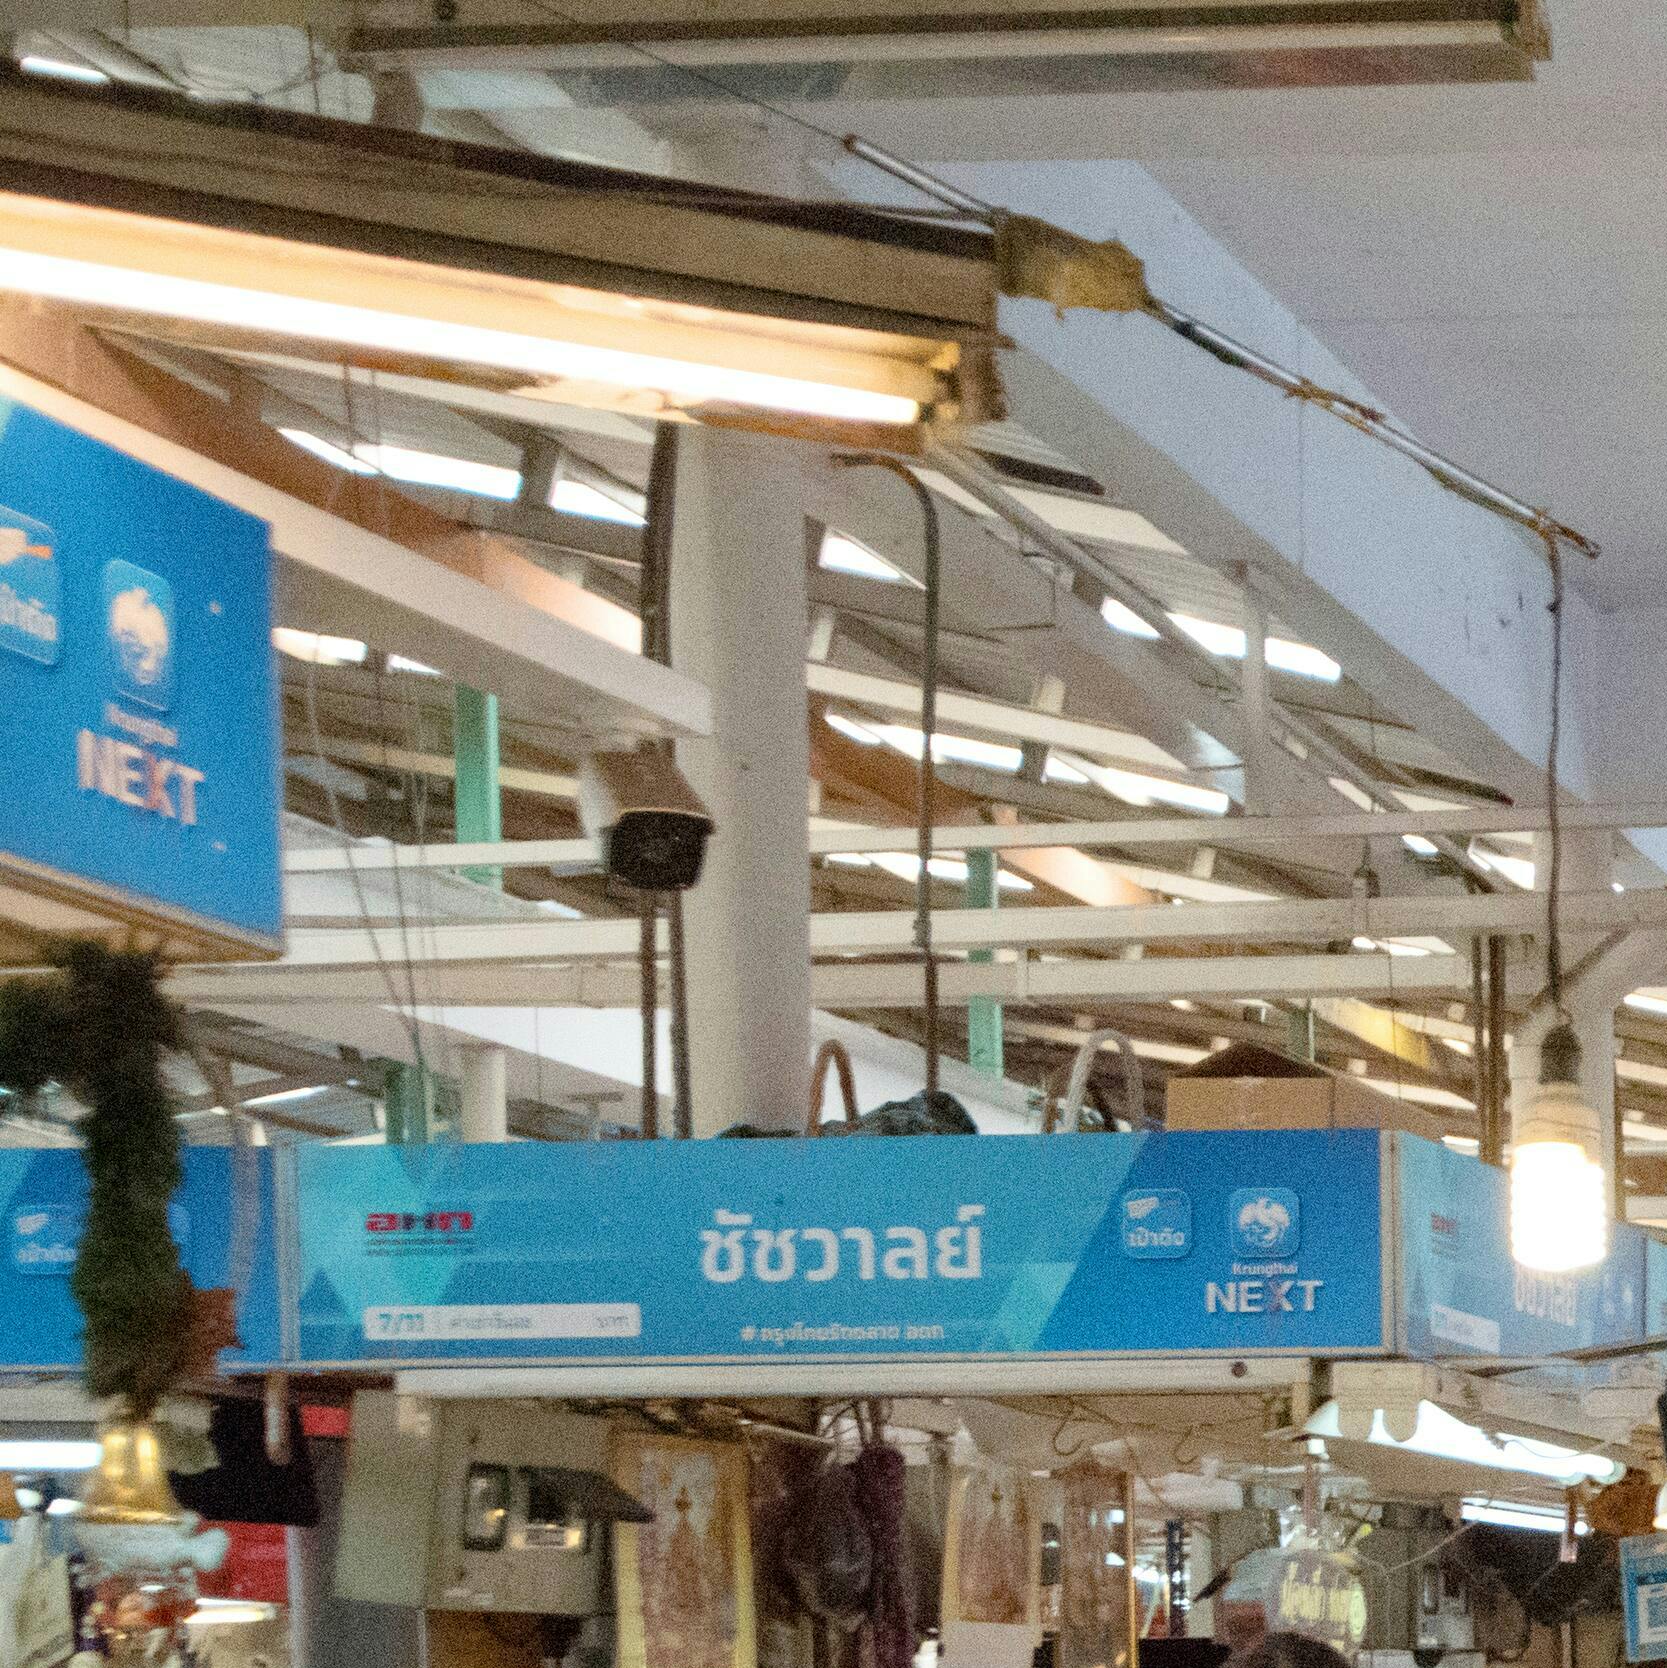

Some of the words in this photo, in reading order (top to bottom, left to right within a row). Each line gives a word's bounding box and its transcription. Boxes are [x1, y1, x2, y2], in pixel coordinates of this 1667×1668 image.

[77, 728, 206, 826] NEXT
[700, 1204, 988, 1285] ชัชวาลย์
[1204, 1279, 1325, 1313] NEXT
